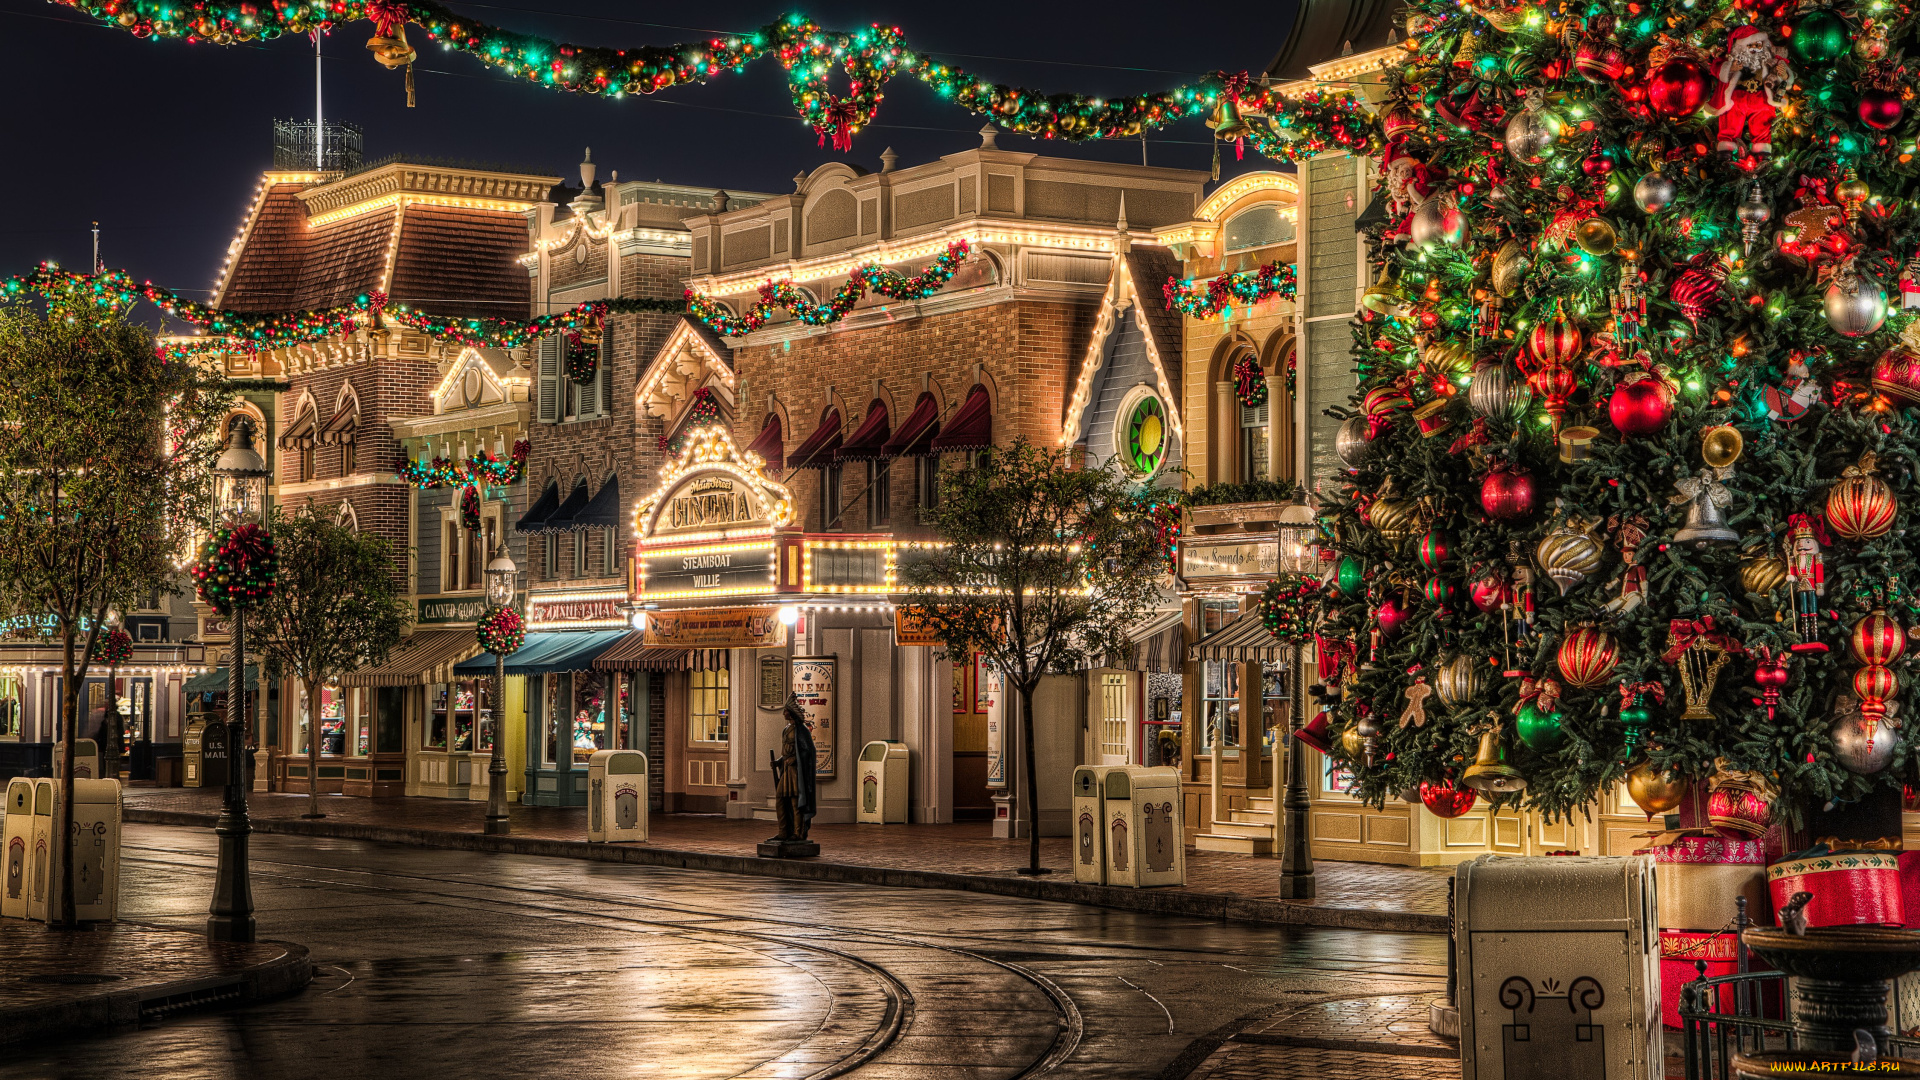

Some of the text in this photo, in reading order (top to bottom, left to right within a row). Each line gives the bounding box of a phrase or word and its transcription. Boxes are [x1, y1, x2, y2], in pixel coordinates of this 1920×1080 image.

[690, 476, 732, 495] Main Street
[670, 491, 752, 527] CINEMA
[682, 554, 731, 570] STEAMBOAT
[693, 573, 721, 588] WILLIE
[425, 603, 455, 619] CANNED
[546, 602, 611, 620] DISNEYANA
[791, 683, 832, 692] INEMA
[204, 751, 227, 759] MAIL
